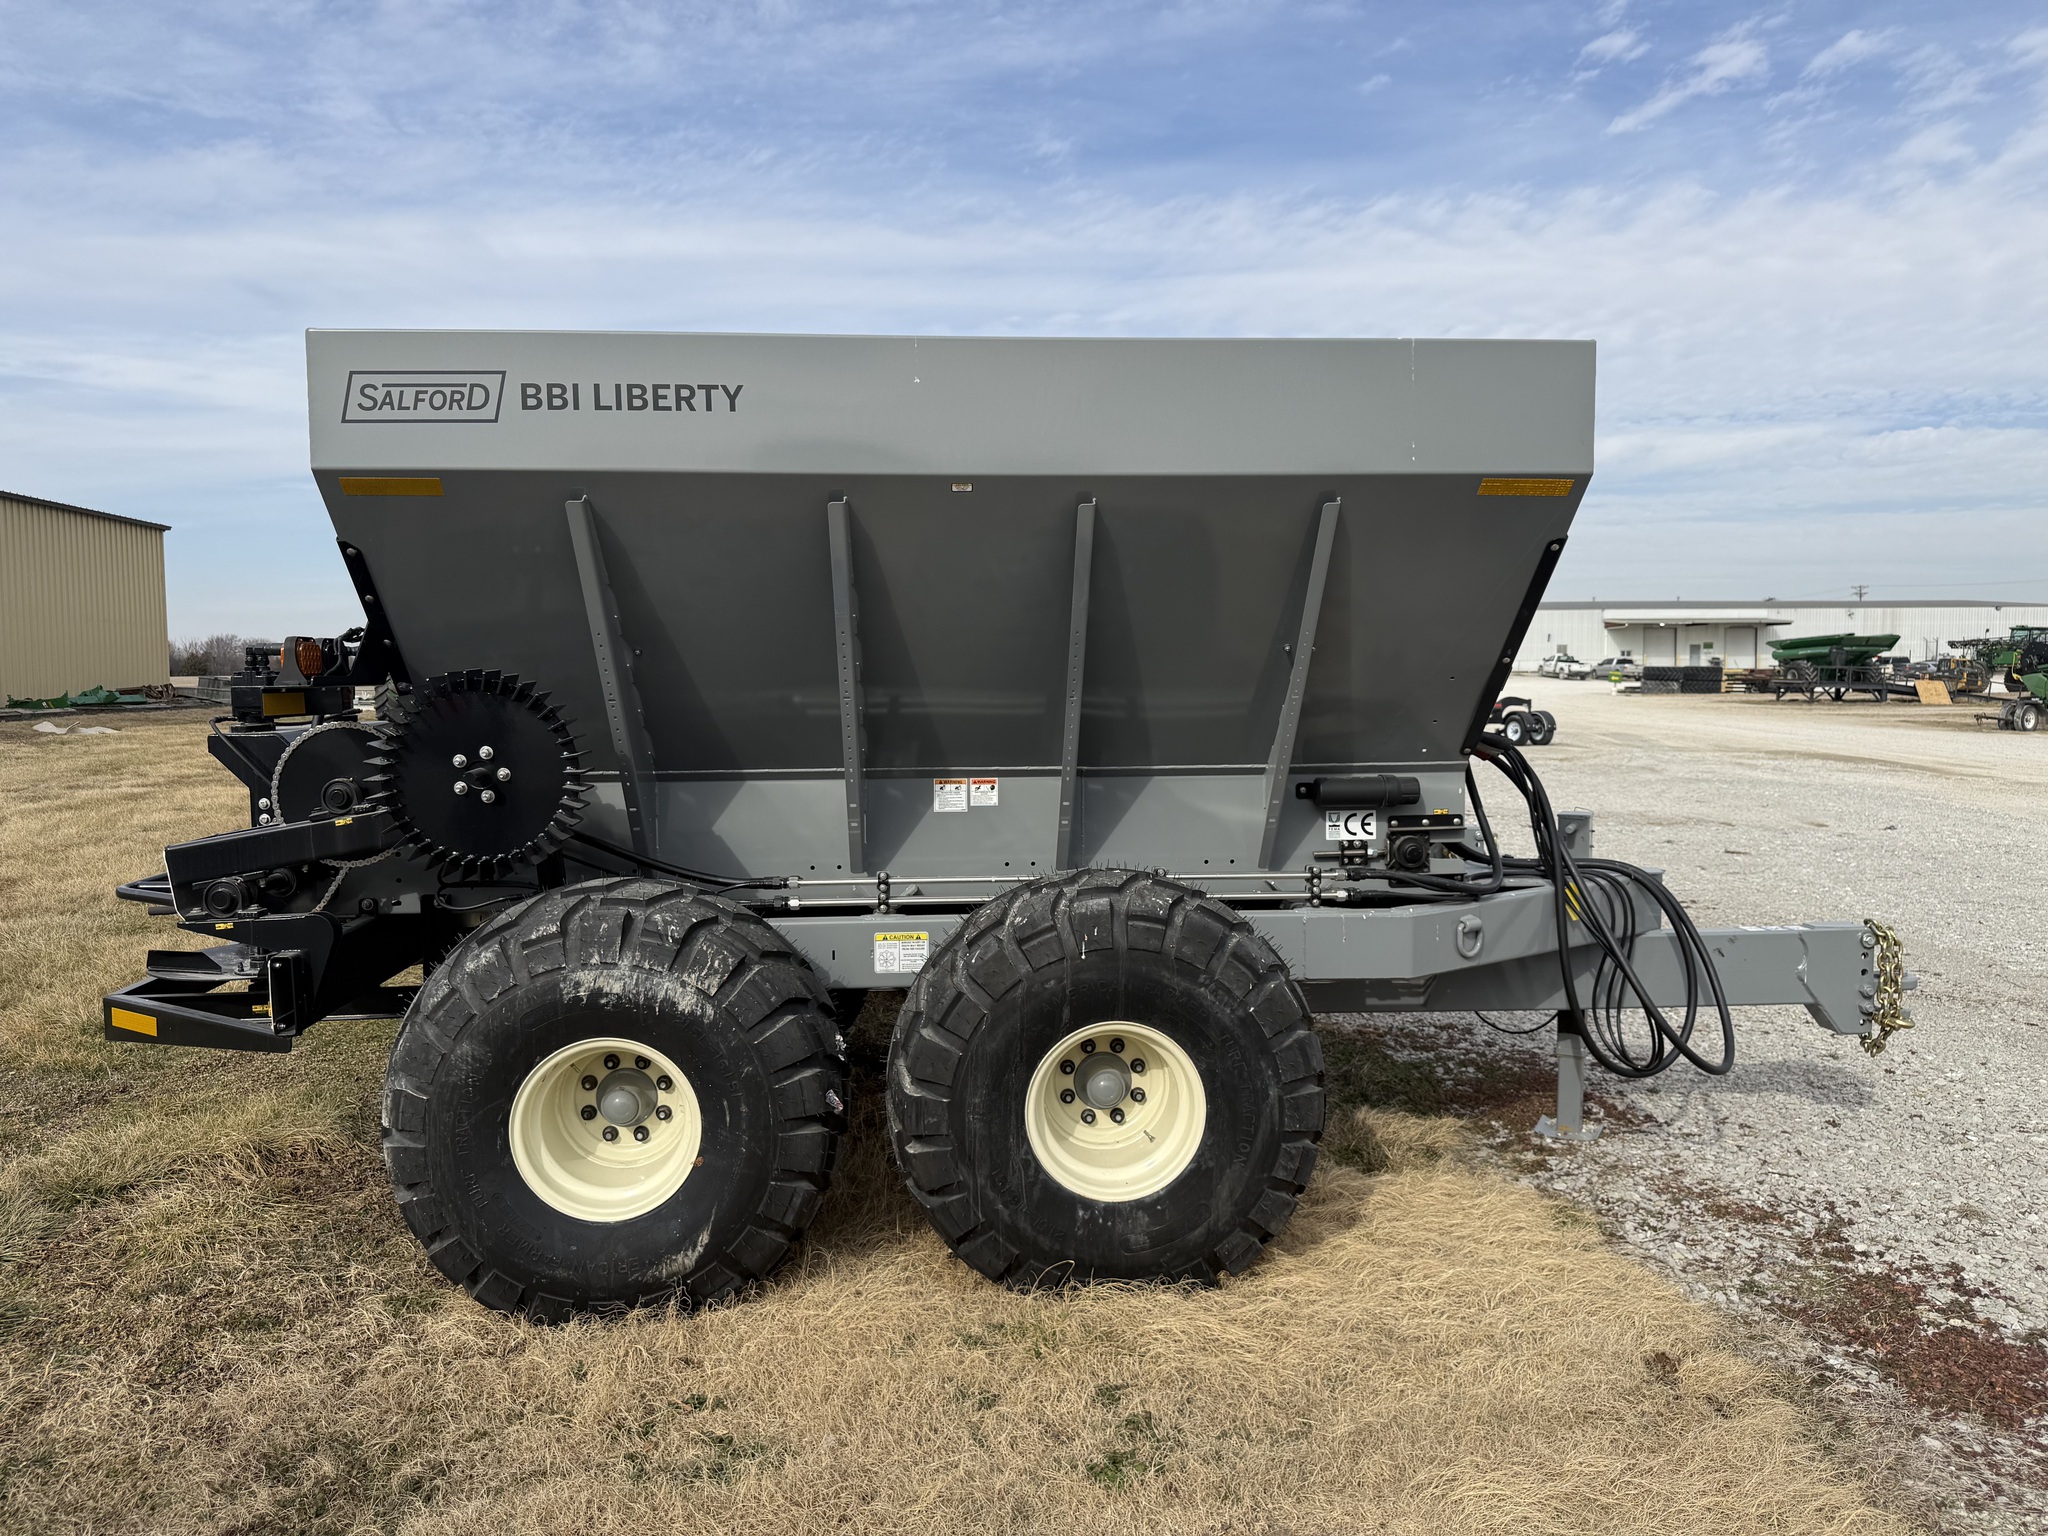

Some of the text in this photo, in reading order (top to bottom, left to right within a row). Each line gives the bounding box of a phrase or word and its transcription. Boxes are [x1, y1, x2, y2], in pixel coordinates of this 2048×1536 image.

[357, 382, 490, 412] SALFORD
[520, 382, 744, 412] BBI LIBERTY
[1343, 812, 1374, 837] CE
[1042, 978, 1133, 1014] AMERICAN
[1233, 1081, 1257, 1167] TRACTION
